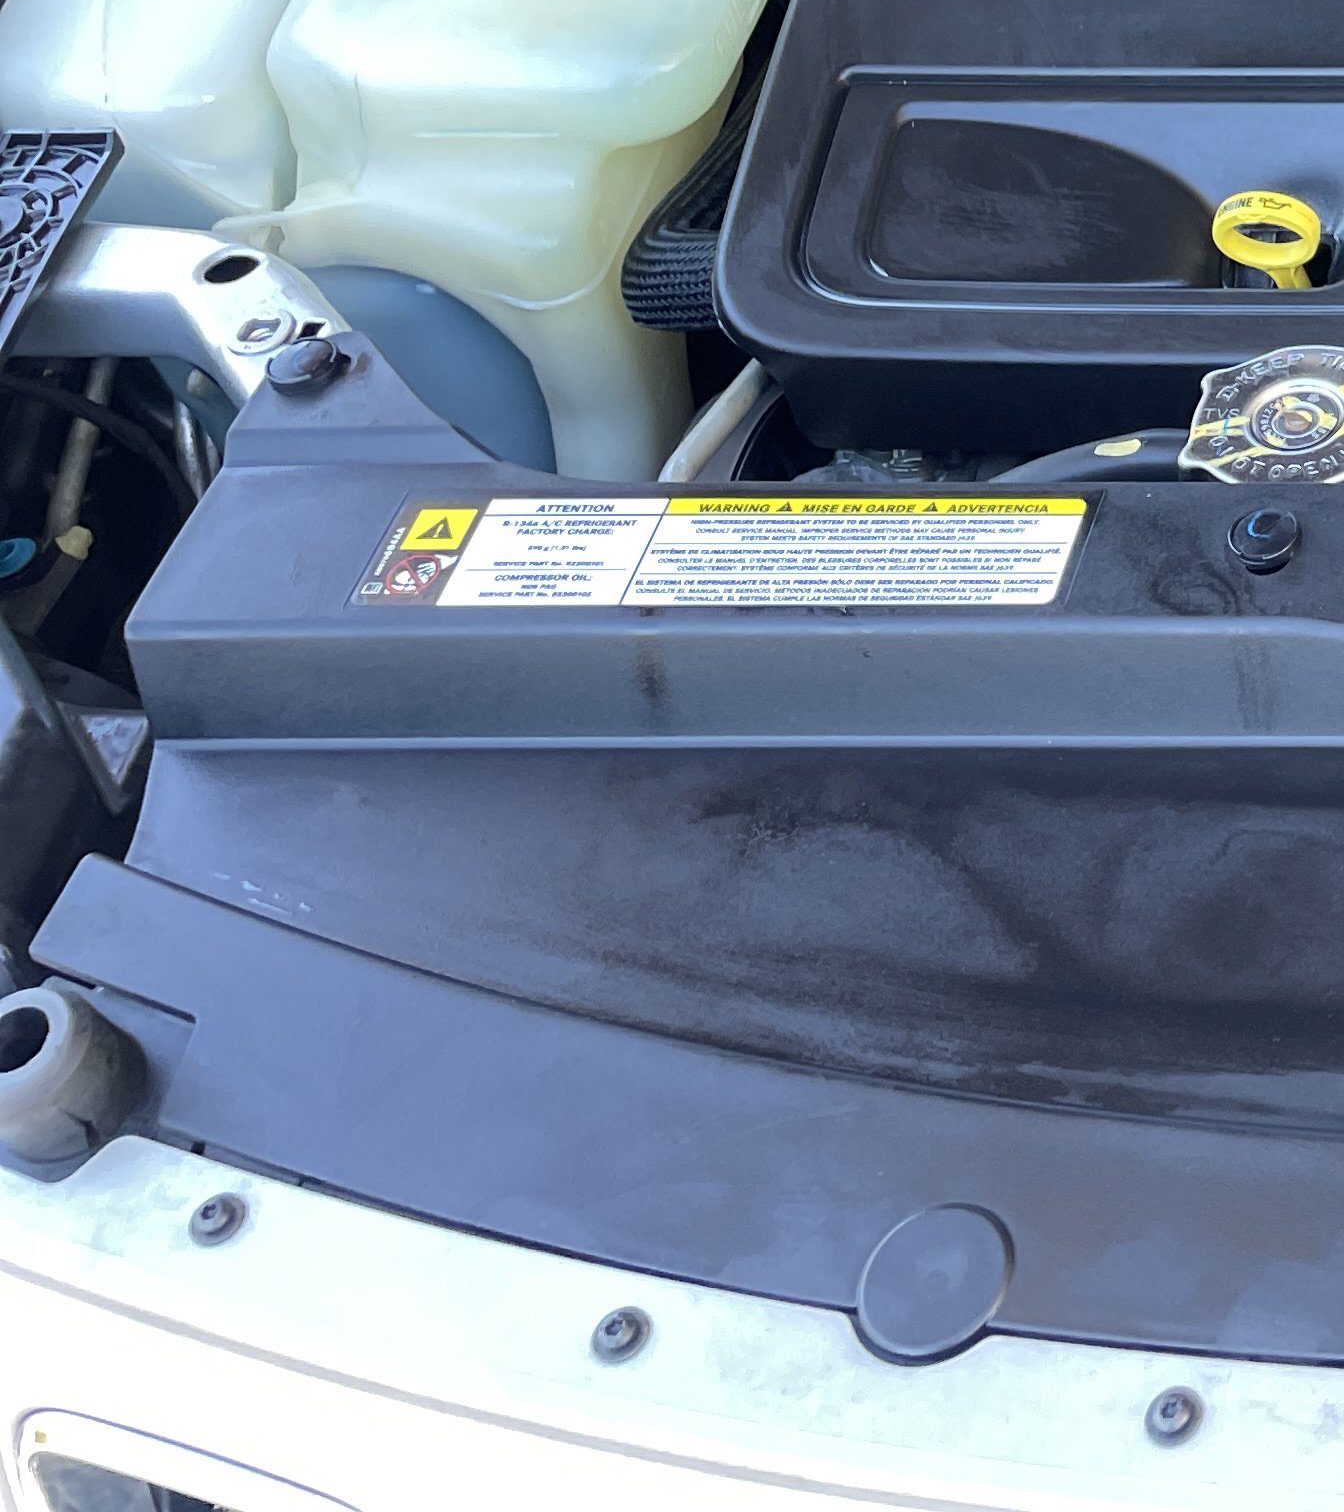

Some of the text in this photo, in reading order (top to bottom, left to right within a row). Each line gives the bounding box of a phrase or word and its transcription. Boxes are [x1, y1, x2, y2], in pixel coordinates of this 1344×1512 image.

[1237, 353, 1305, 385] KEEP
[1203, 407, 1241, 419] TVS
[1268, 453, 1340, 481] OPEN
[536, 504, 615, 514] ATTENTION
[699, 503, 1049, 513] WARNING MISE EN GARDE ADVERTENCIA
[541, 520, 563, 528] A/C
[564, 520, 638, 528] REFRIGERANT
[516, 528, 565, 536] FACTORY
[493, 560, 527, 568] SERVICE
[528, 560, 549, 568] PART
[494, 574, 569, 582] COMPRESSOR
